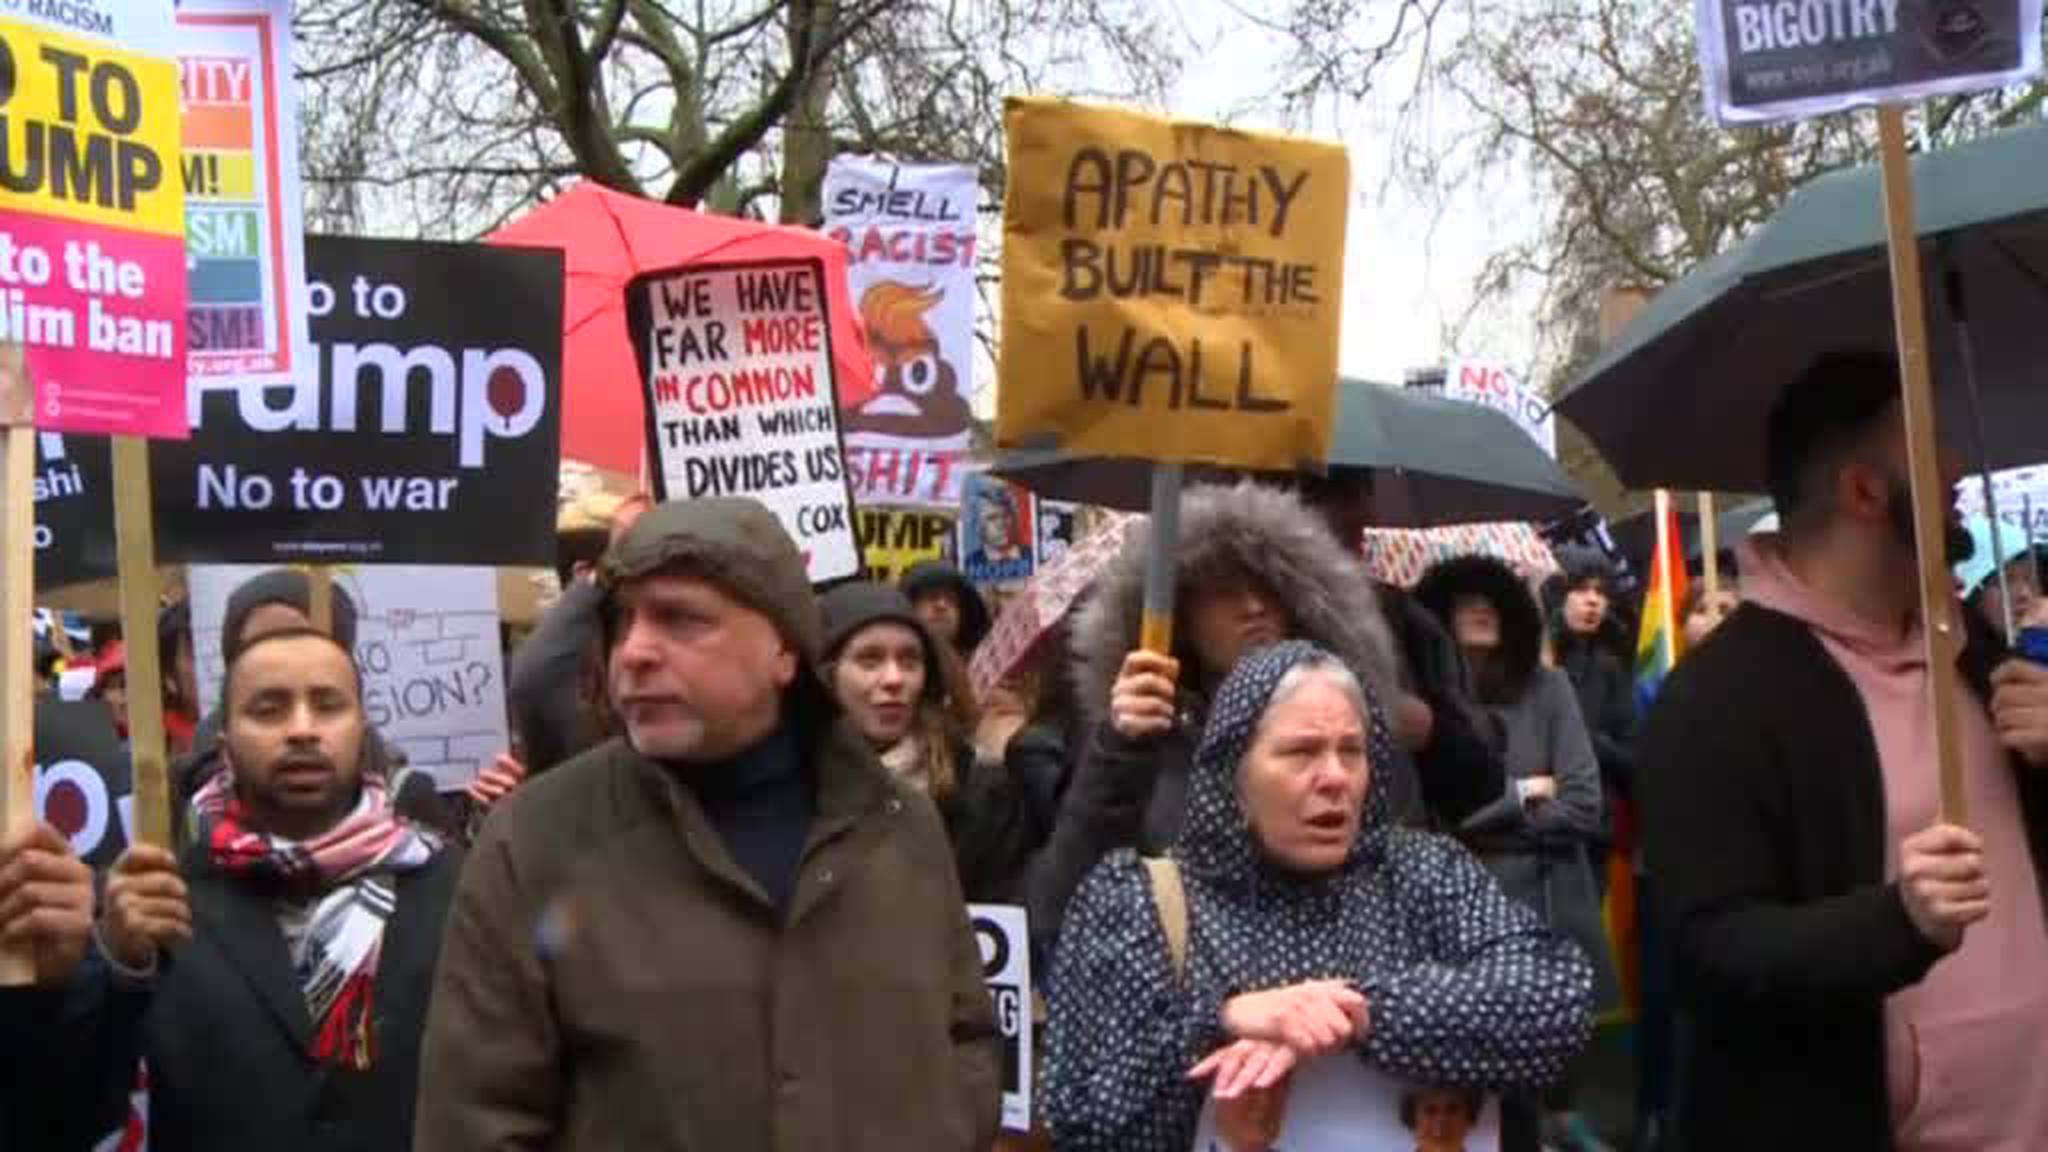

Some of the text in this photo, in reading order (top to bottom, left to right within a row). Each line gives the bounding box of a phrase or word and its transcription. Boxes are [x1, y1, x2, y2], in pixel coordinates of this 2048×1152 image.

[27, 0, 113, 36] RACISM
[1734, 0, 1898, 53] BIGOTRY
[40, 46, 142, 135] TO
[179, 61, 250, 101] ITY
[0, 116, 162, 212] UMP
[832, 190, 961, 221] SMELL
[1062, 146, 1309, 237] APATHY
[0, 232, 145, 298] to the
[830, 227, 977, 269] RACIST
[1060, 238, 1320, 304] BUILT THE
[305, 276, 405, 318] o to
[662, 271, 812, 321] WE HAVE
[0, 286, 172, 359] lim ban
[657, 316, 821, 369] FAR MORE
[655, 369, 817, 414] IN COMMON
[1076, 322, 1293, 413] WALL
[190, 338, 546, 467] ump
[663, 407, 833, 449] THAN WHICH
[198, 464, 458, 511] No to war
[687, 447, 842, 499] DIVIDES US
[848, 449, 961, 497] SHIT
[799, 504, 848, 537] COX
[858, 510, 946, 551] UMP
[365, 660, 493, 728] SION?
